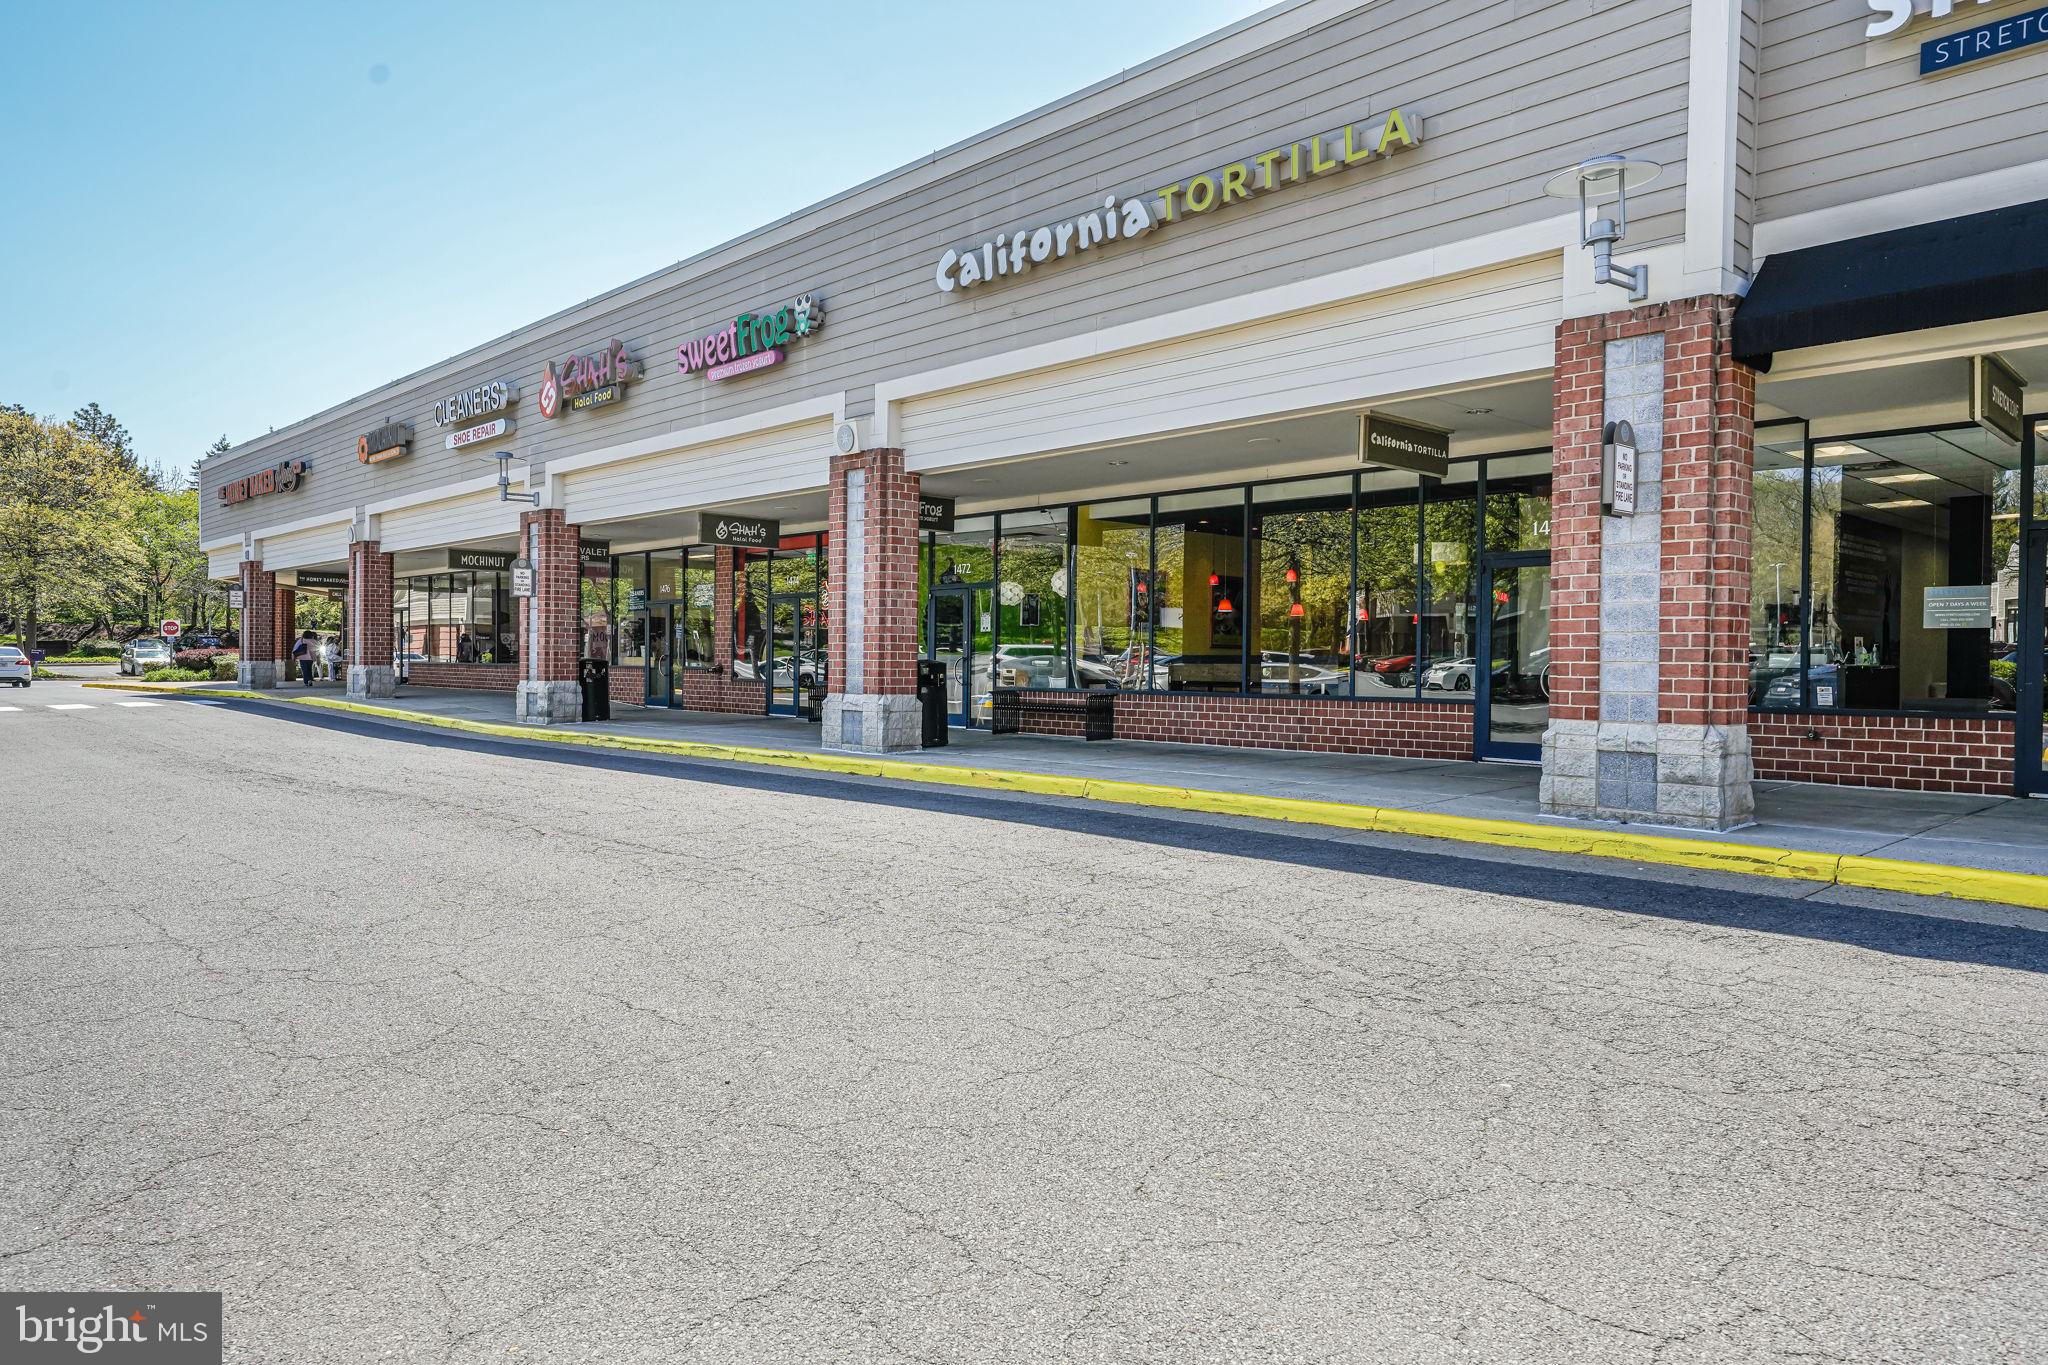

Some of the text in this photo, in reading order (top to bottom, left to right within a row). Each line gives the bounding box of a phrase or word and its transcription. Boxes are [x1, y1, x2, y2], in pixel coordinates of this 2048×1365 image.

[936, 109, 1413, 293] California TORTILLA
[434, 381, 500, 427] CLEANERS
[574, 388, 612, 409] Halal Food
[453, 423, 496, 446] SHOE REPAIR
[1370, 432, 1447, 459] California TORTILLA
[1617, 461, 1632, 473] PARKING
[1616, 480, 1633, 491] STANDING
[579, 546, 608, 557] VALET
[461, 555, 506, 568] MOCHINUT
[953, 563, 972, 575] 1472
